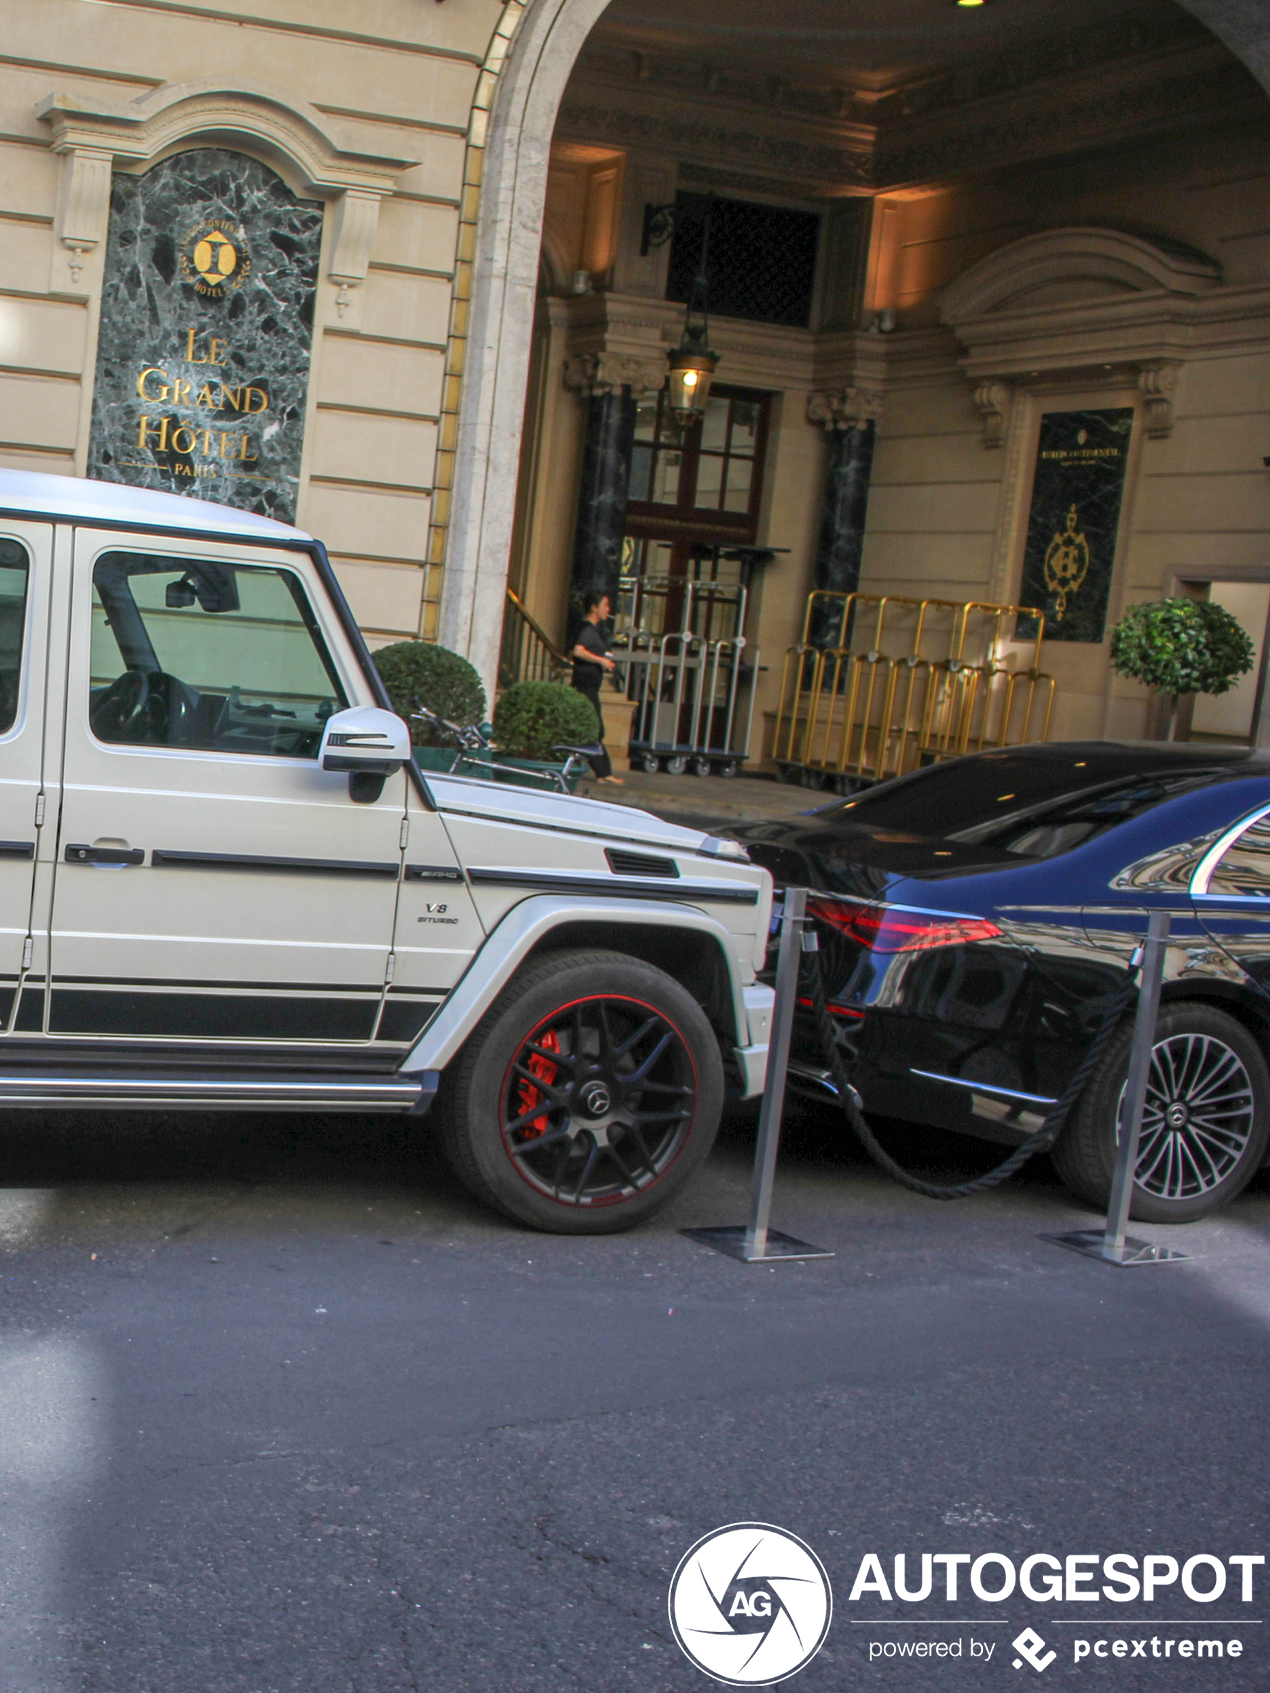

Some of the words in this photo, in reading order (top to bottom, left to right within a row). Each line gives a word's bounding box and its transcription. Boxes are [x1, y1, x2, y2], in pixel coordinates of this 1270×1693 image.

[194, 282, 230, 297] HOTELS
[183, 328, 228, 366] LE
[136, 367, 270, 414] GRAND
[136, 414, 259, 461] HÔTEL
[174, 462, 218, 478] PARIS
[426, 903, 447, 913] V8
